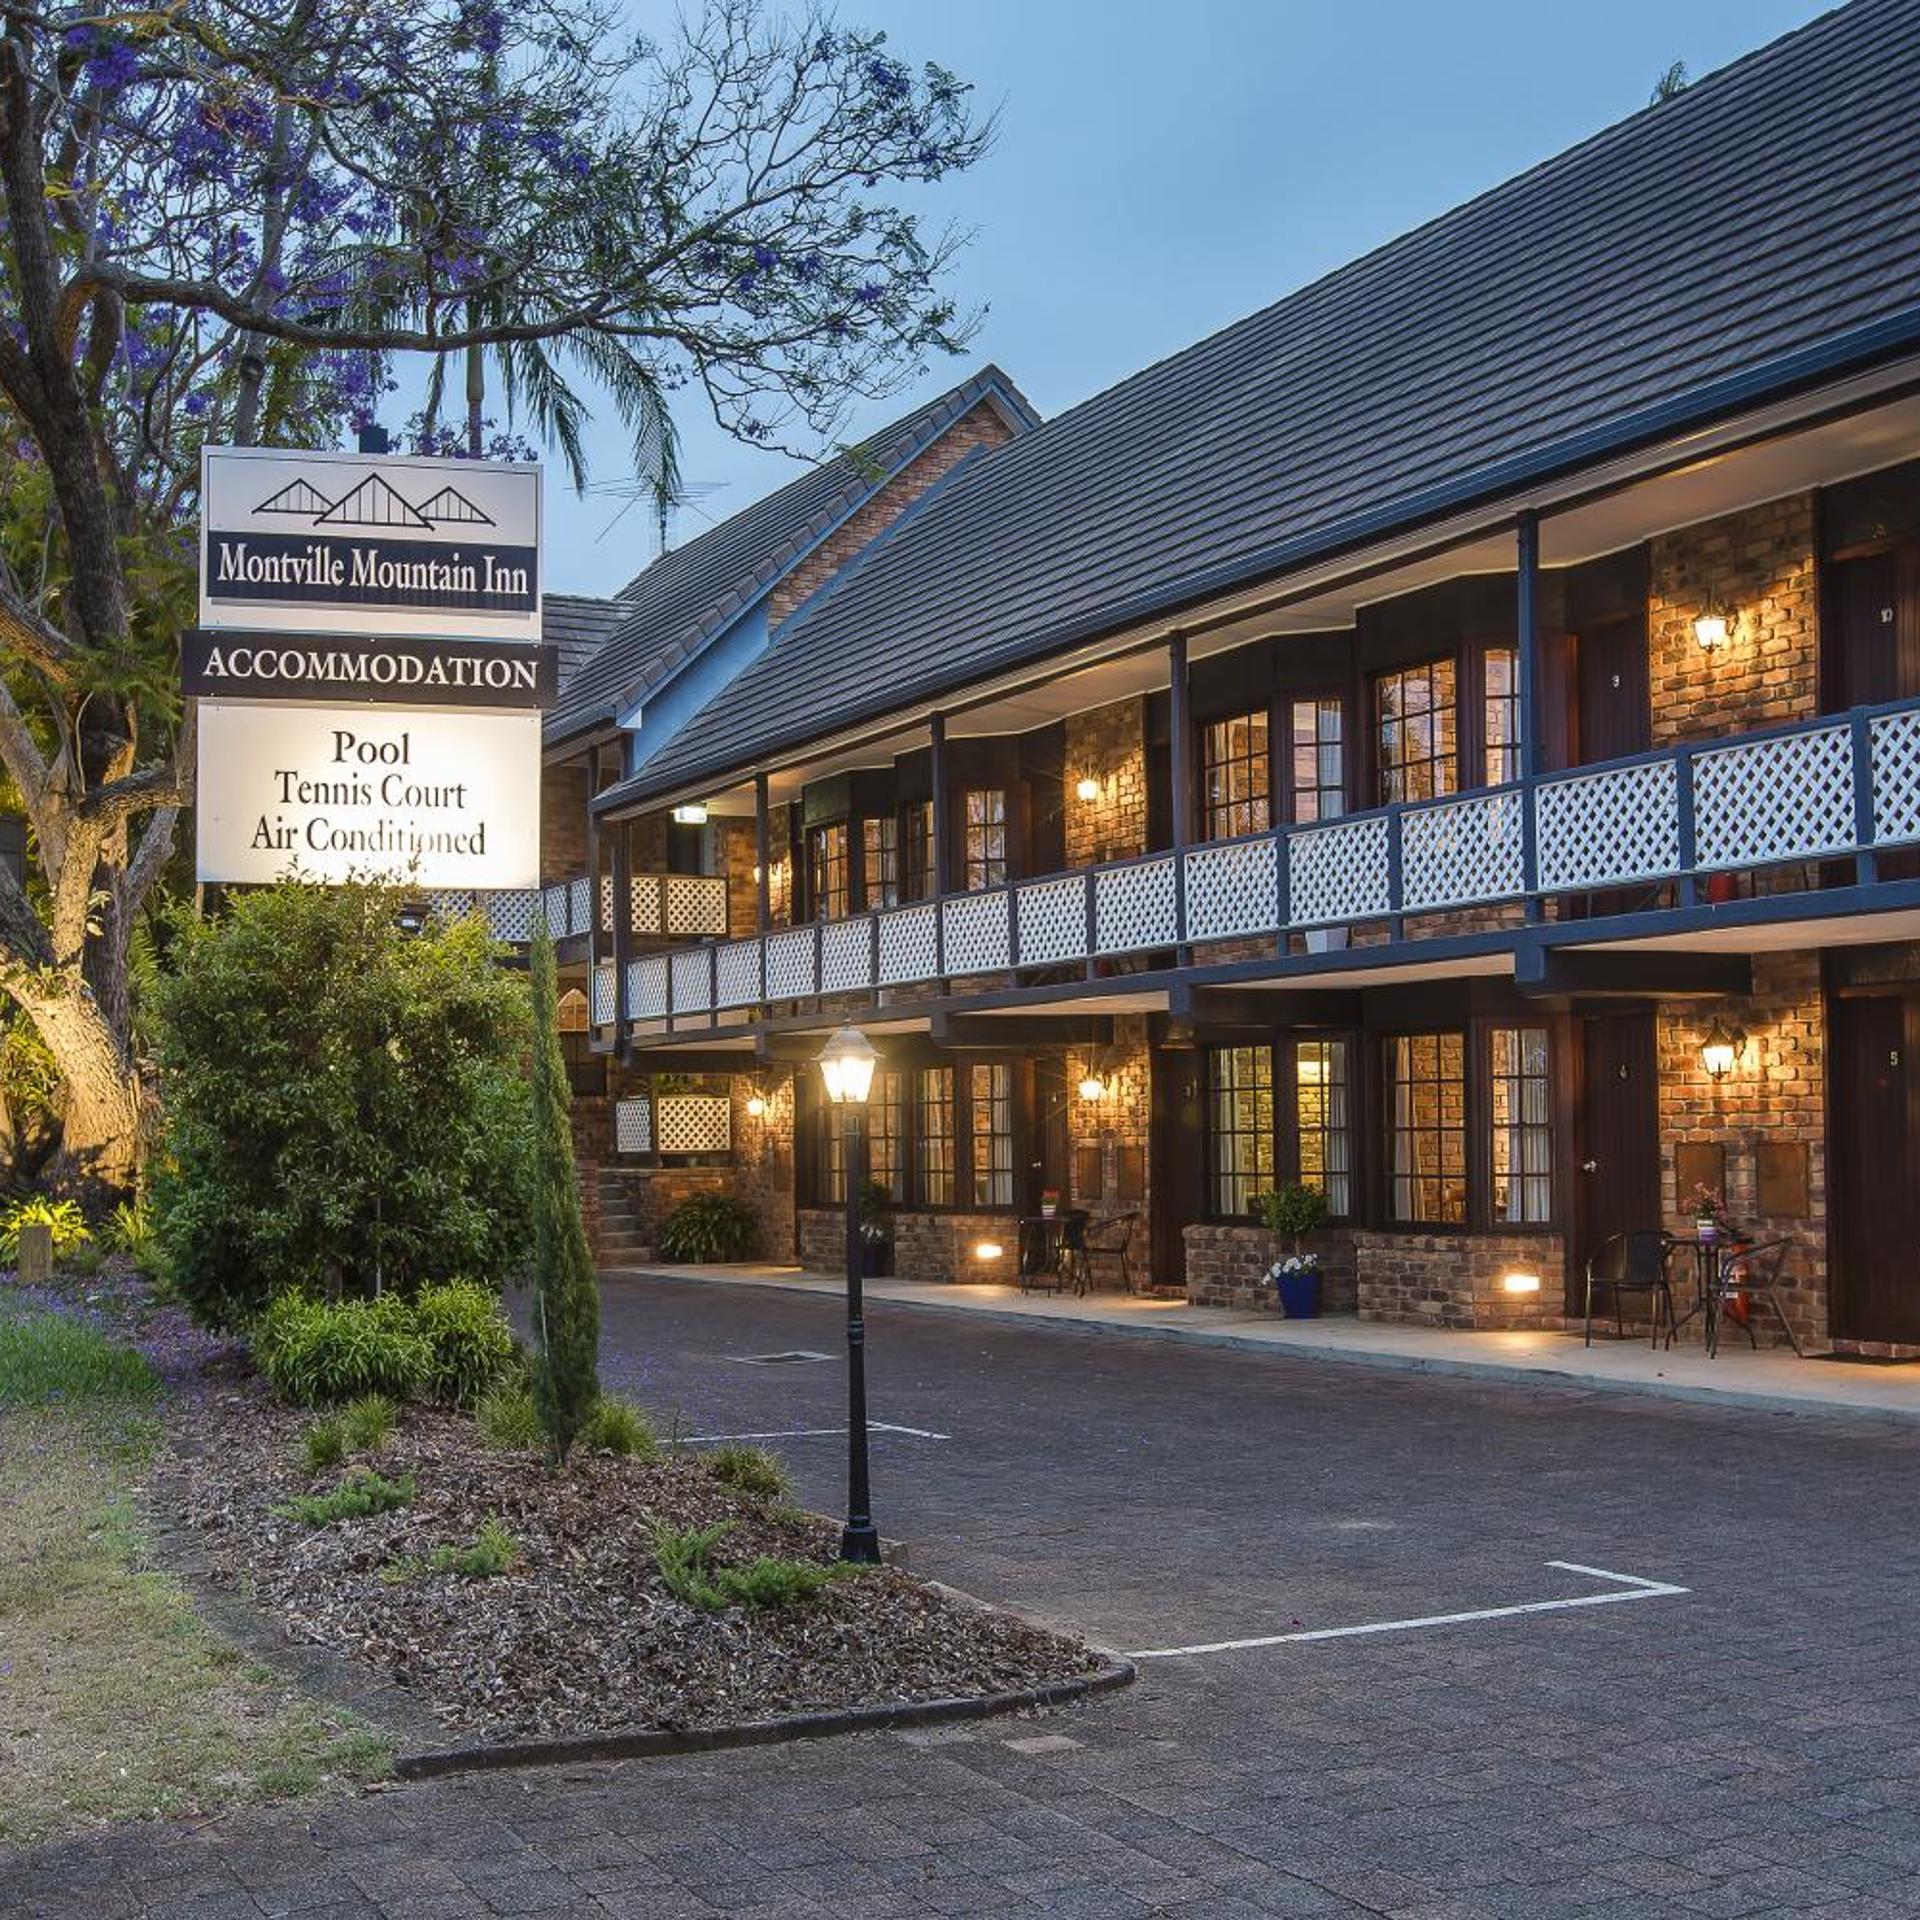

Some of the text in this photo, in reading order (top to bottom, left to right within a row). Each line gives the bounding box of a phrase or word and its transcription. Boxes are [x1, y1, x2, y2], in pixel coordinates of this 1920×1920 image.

[217, 542, 529, 595] Montville Mountain Inn
[203, 647, 539, 689] ACCOMMODATION
[332, 730, 411, 765] Pool
[275, 770, 468, 809] Tennis Court
[250, 815, 486, 856] Air Conditioned
